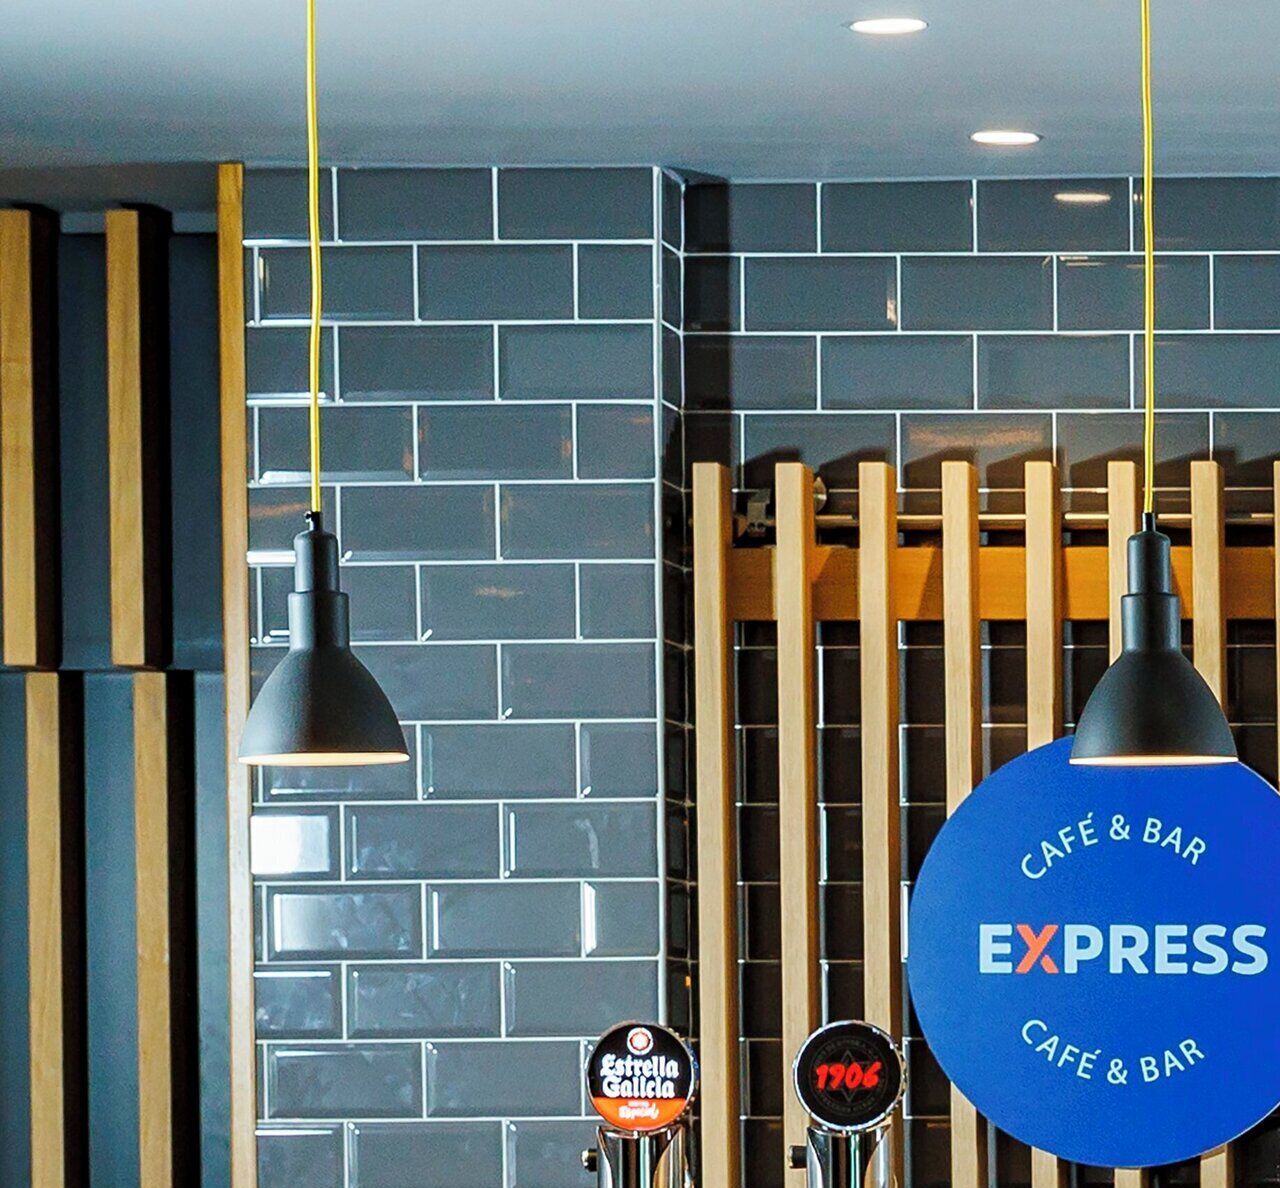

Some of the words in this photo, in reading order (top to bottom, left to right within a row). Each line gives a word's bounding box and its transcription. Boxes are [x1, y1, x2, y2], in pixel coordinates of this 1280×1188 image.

[1020, 812, 1099, 879] CAFÉ
[1109, 814, 1130, 840] &
[1142, 818, 1206, 866] BAR
[980, 924, 1269, 975] EXPRESS
[600, 1054, 679, 1078] Estrella
[1021, 1019, 1100, 1080] CAFÉ
[1107, 1058, 1128, 1085] &
[1140, 1038, 1205, 1082] BAR
[602, 1075, 675, 1098] Galicia
[816, 1061, 882, 1092] 1906
